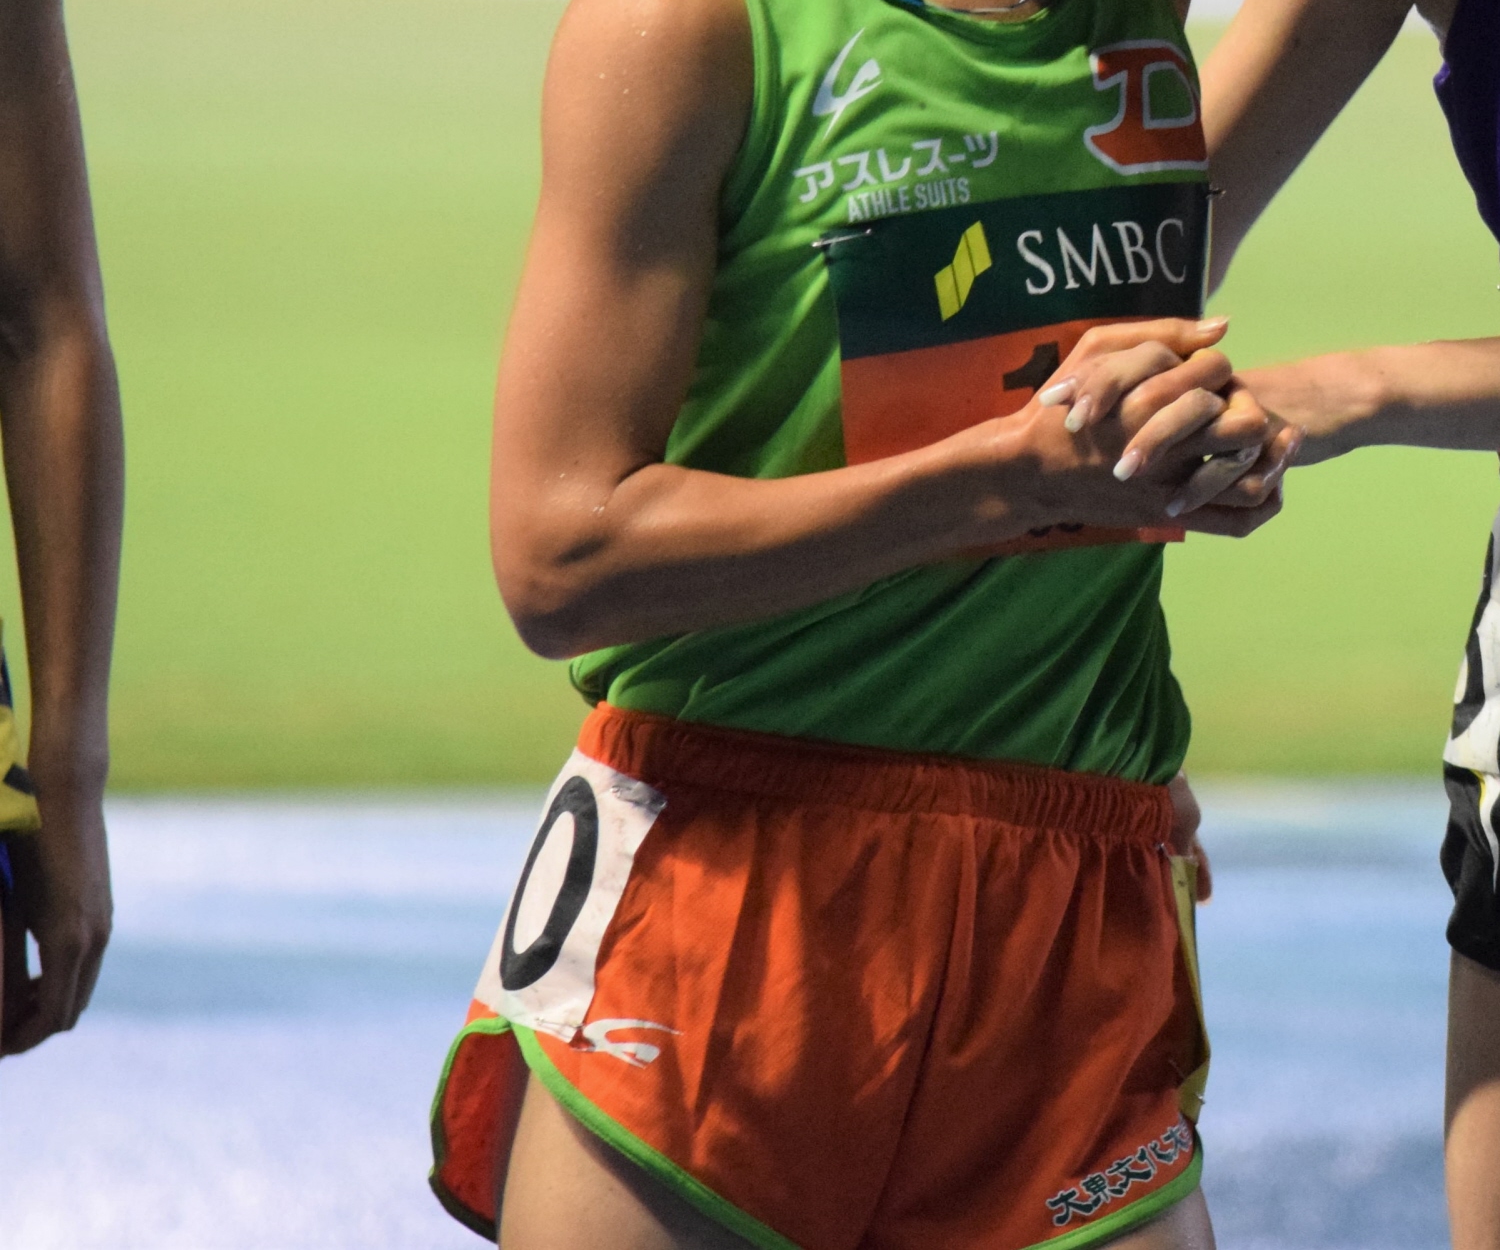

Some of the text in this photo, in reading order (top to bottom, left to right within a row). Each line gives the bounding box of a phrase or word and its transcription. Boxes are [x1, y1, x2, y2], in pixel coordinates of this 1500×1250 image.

[793, 132, 999, 203] アスレスーツ
[846, 178, 970, 223] ATHLE SUITS
[1016, 218, 1187, 295] SMBC
[500, 776, 599, 991] 0
